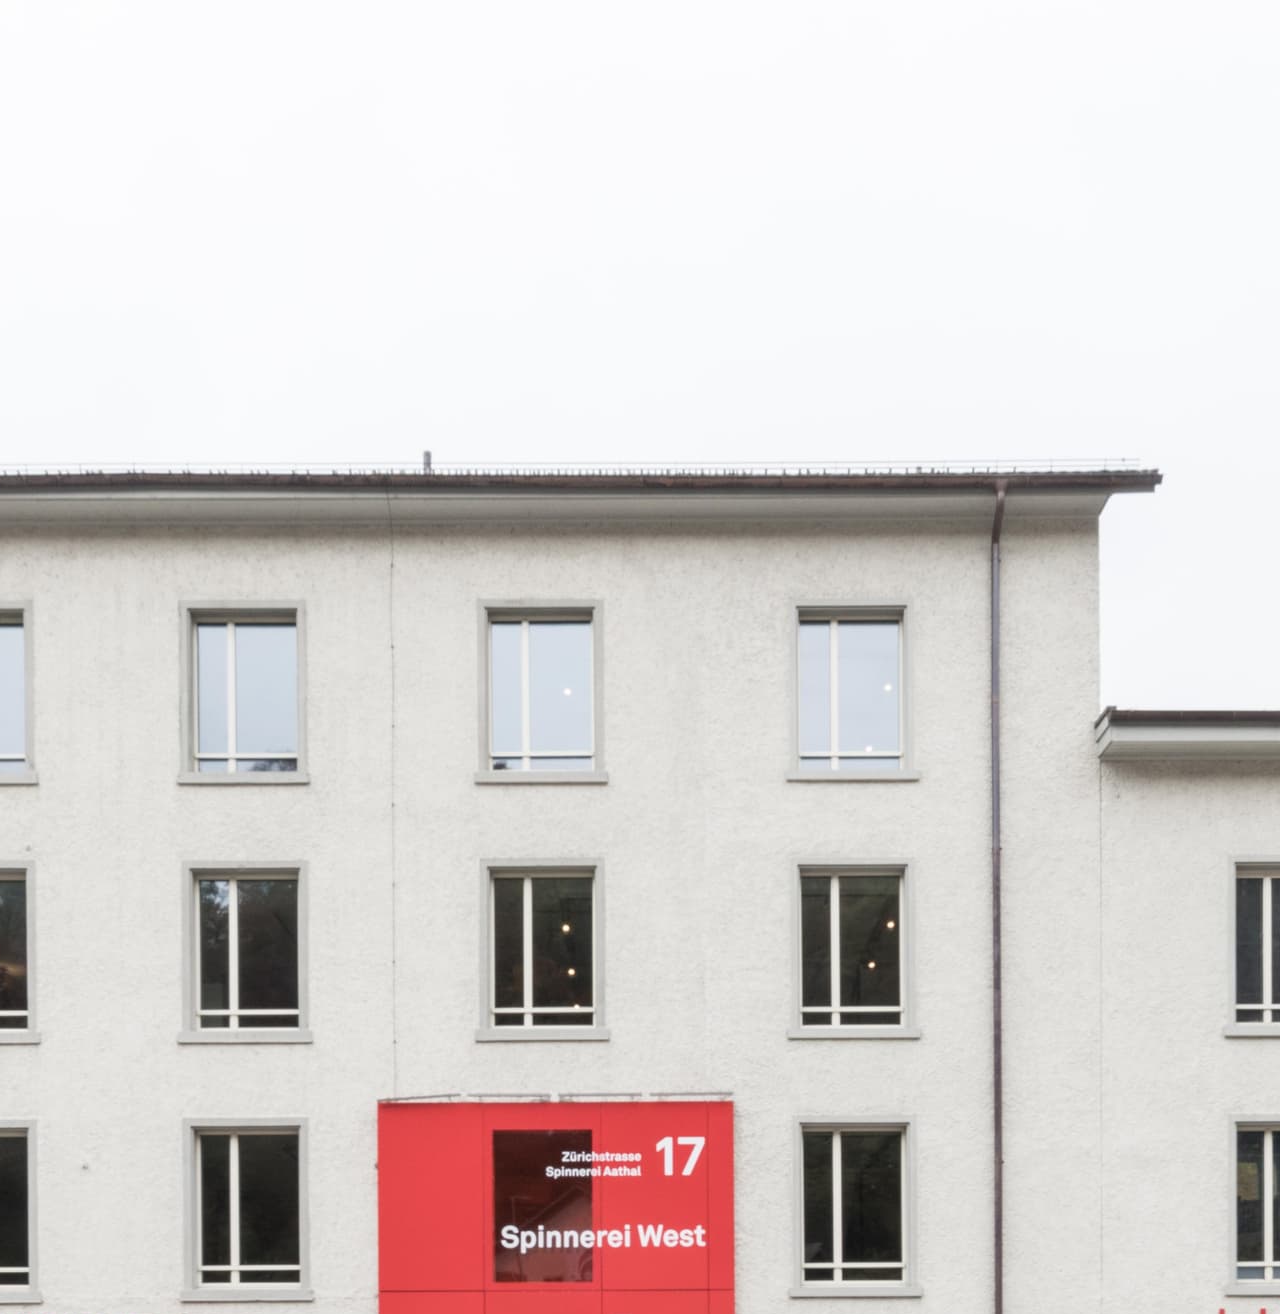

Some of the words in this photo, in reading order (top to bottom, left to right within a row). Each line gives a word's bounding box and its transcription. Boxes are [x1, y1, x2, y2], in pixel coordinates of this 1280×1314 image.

[561, 1151, 642, 1163] Zürichstrasse
[655, 1136, 706, 1176] 17
[545, 1166, 601, 1179] Spinnerei
[603, 1166, 642, 1177] Aathal
[501, 1224, 631, 1254] Spinnerei
[637, 1224, 706, 1247] West
